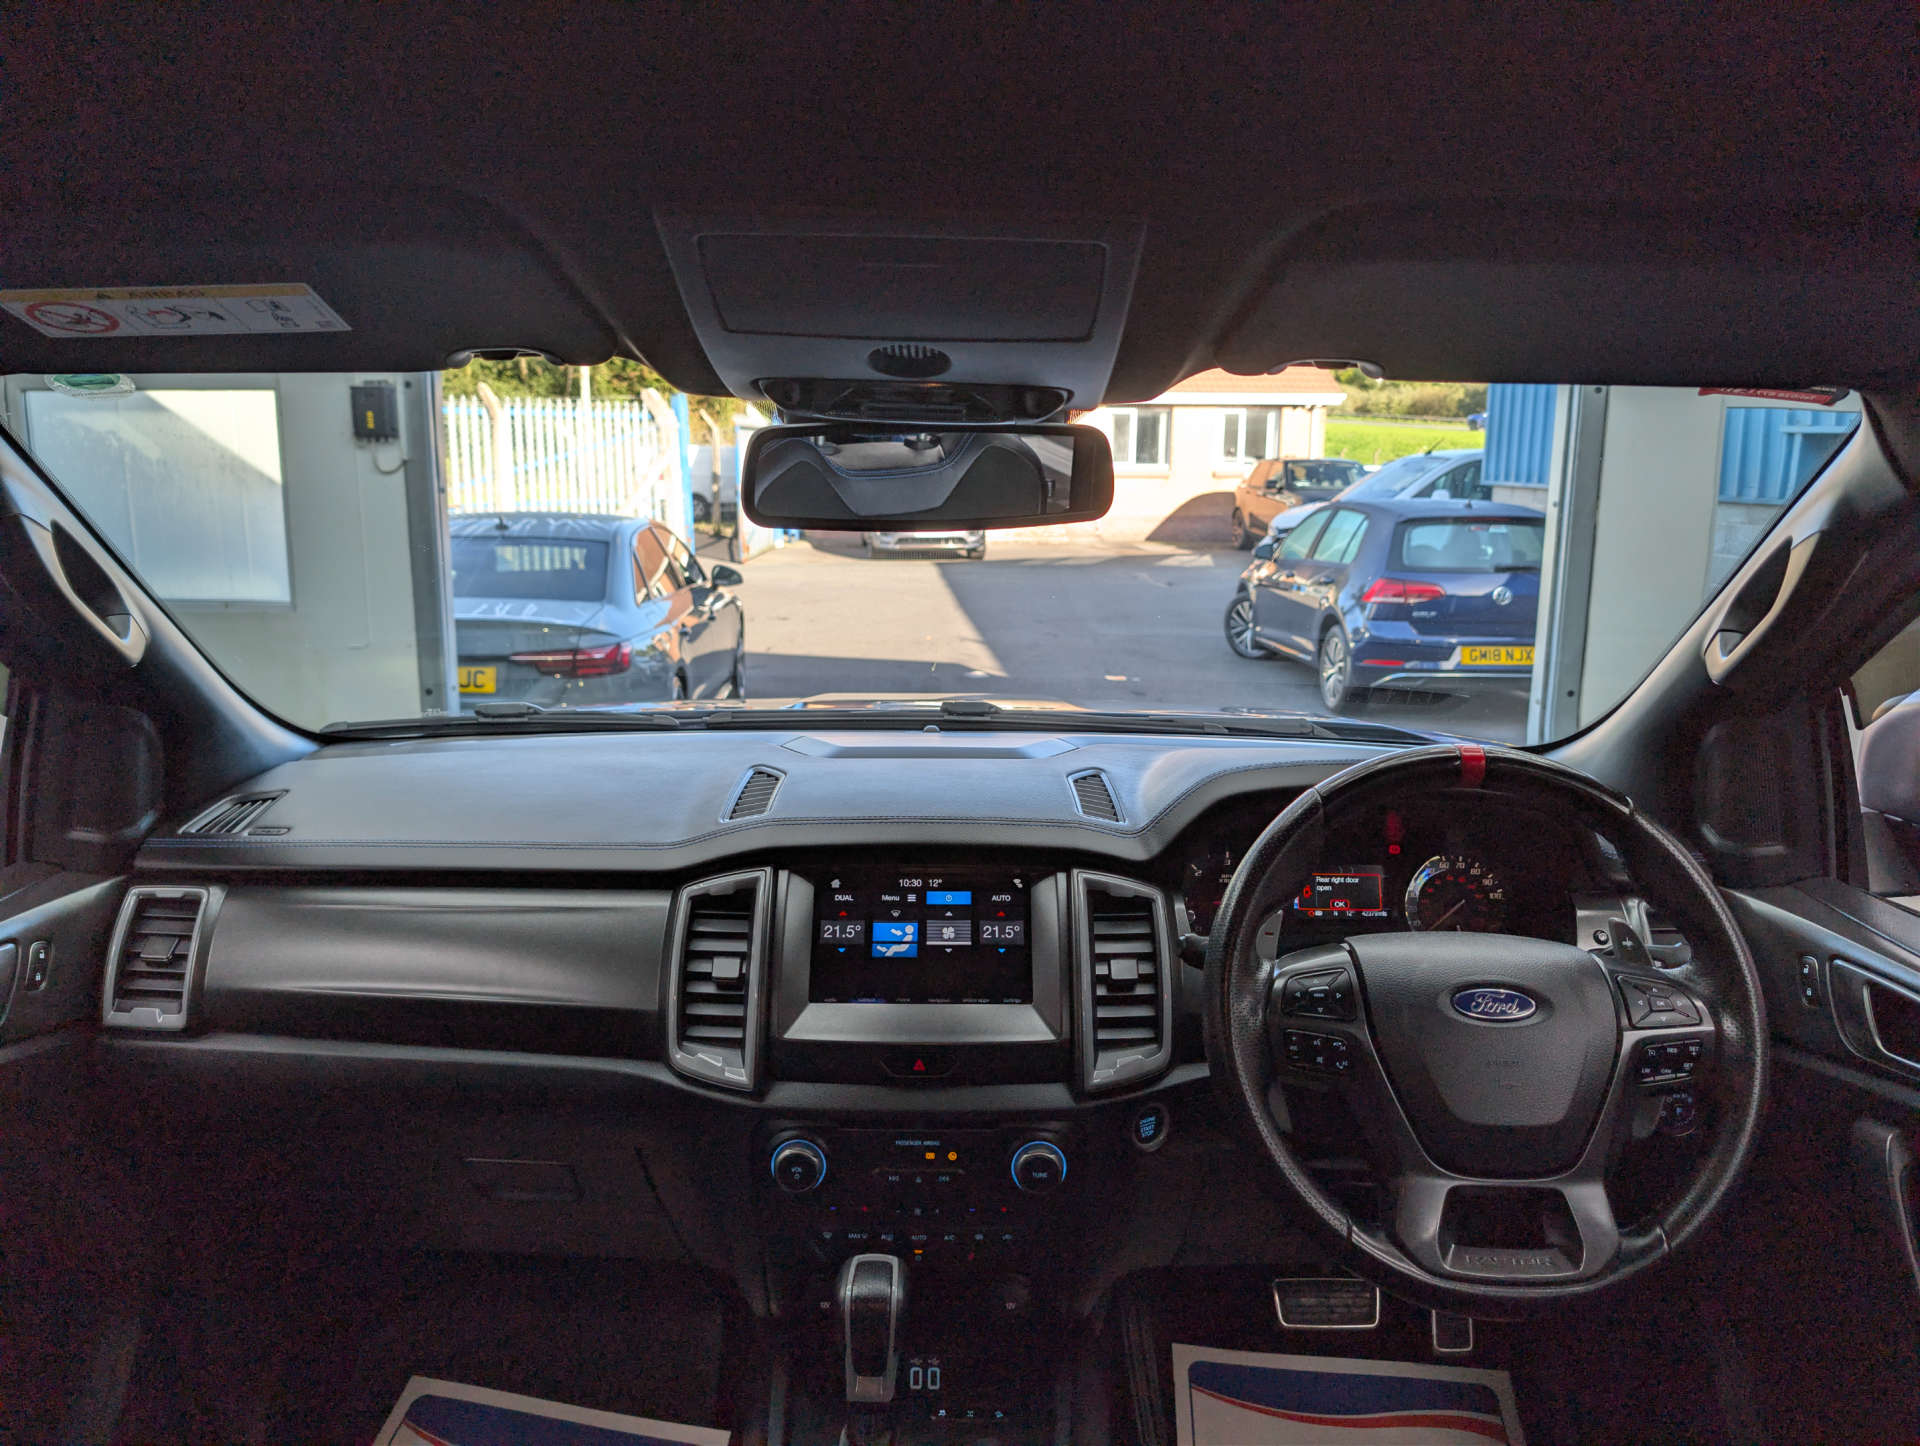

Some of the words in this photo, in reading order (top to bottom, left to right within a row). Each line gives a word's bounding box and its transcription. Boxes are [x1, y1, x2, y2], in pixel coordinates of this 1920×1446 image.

[1469, 650, 1501, 662] GM18
[1505, 650, 1535, 662] NJX
[899, 879, 922, 887] 10:30
[834, 894, 854, 902] DUAL
[881, 894, 900, 902] Menu
[991, 894, 1012, 902] AUTO
[823, 925, 862, 938] 21.5°
[983, 925, 1021, 938] 21.5°
[1470, 992, 1521, 1014] Ford
